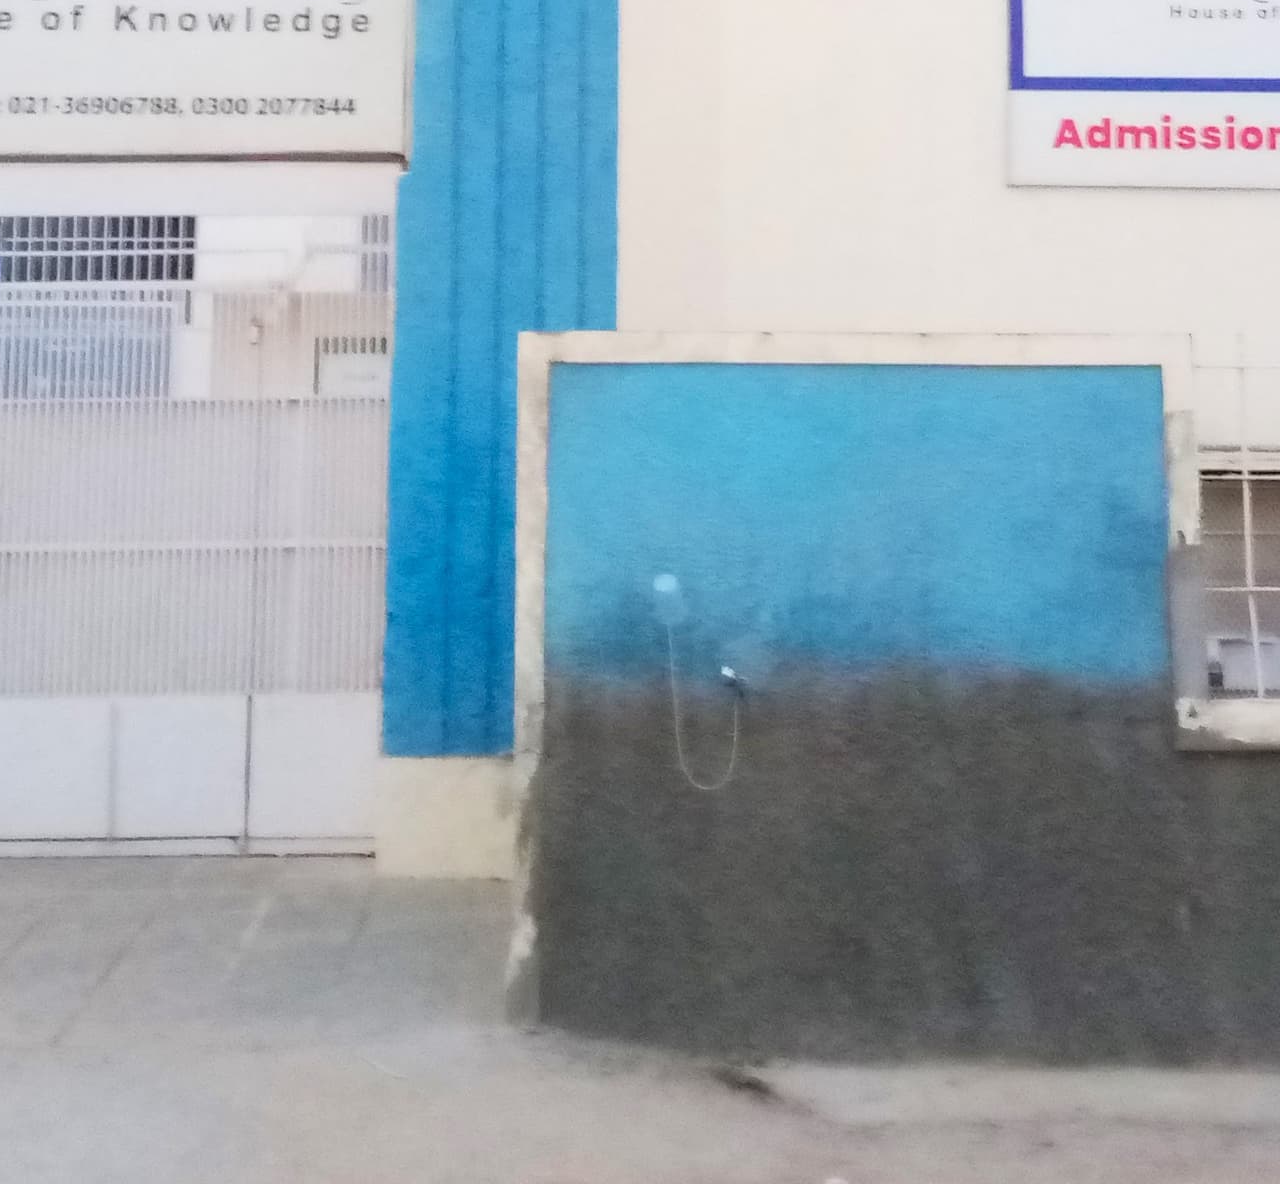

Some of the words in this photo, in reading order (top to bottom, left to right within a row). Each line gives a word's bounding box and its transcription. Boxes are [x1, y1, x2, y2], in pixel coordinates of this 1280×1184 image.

[1169, 4, 1244, 20] House
[1256, 4, 1280, 20] of
[40, 5, 85, 31] of
[114, 5, 370, 39] Knowledge
[191, 97, 250, 116] 0300
[254, 97, 358, 116] 2077844
